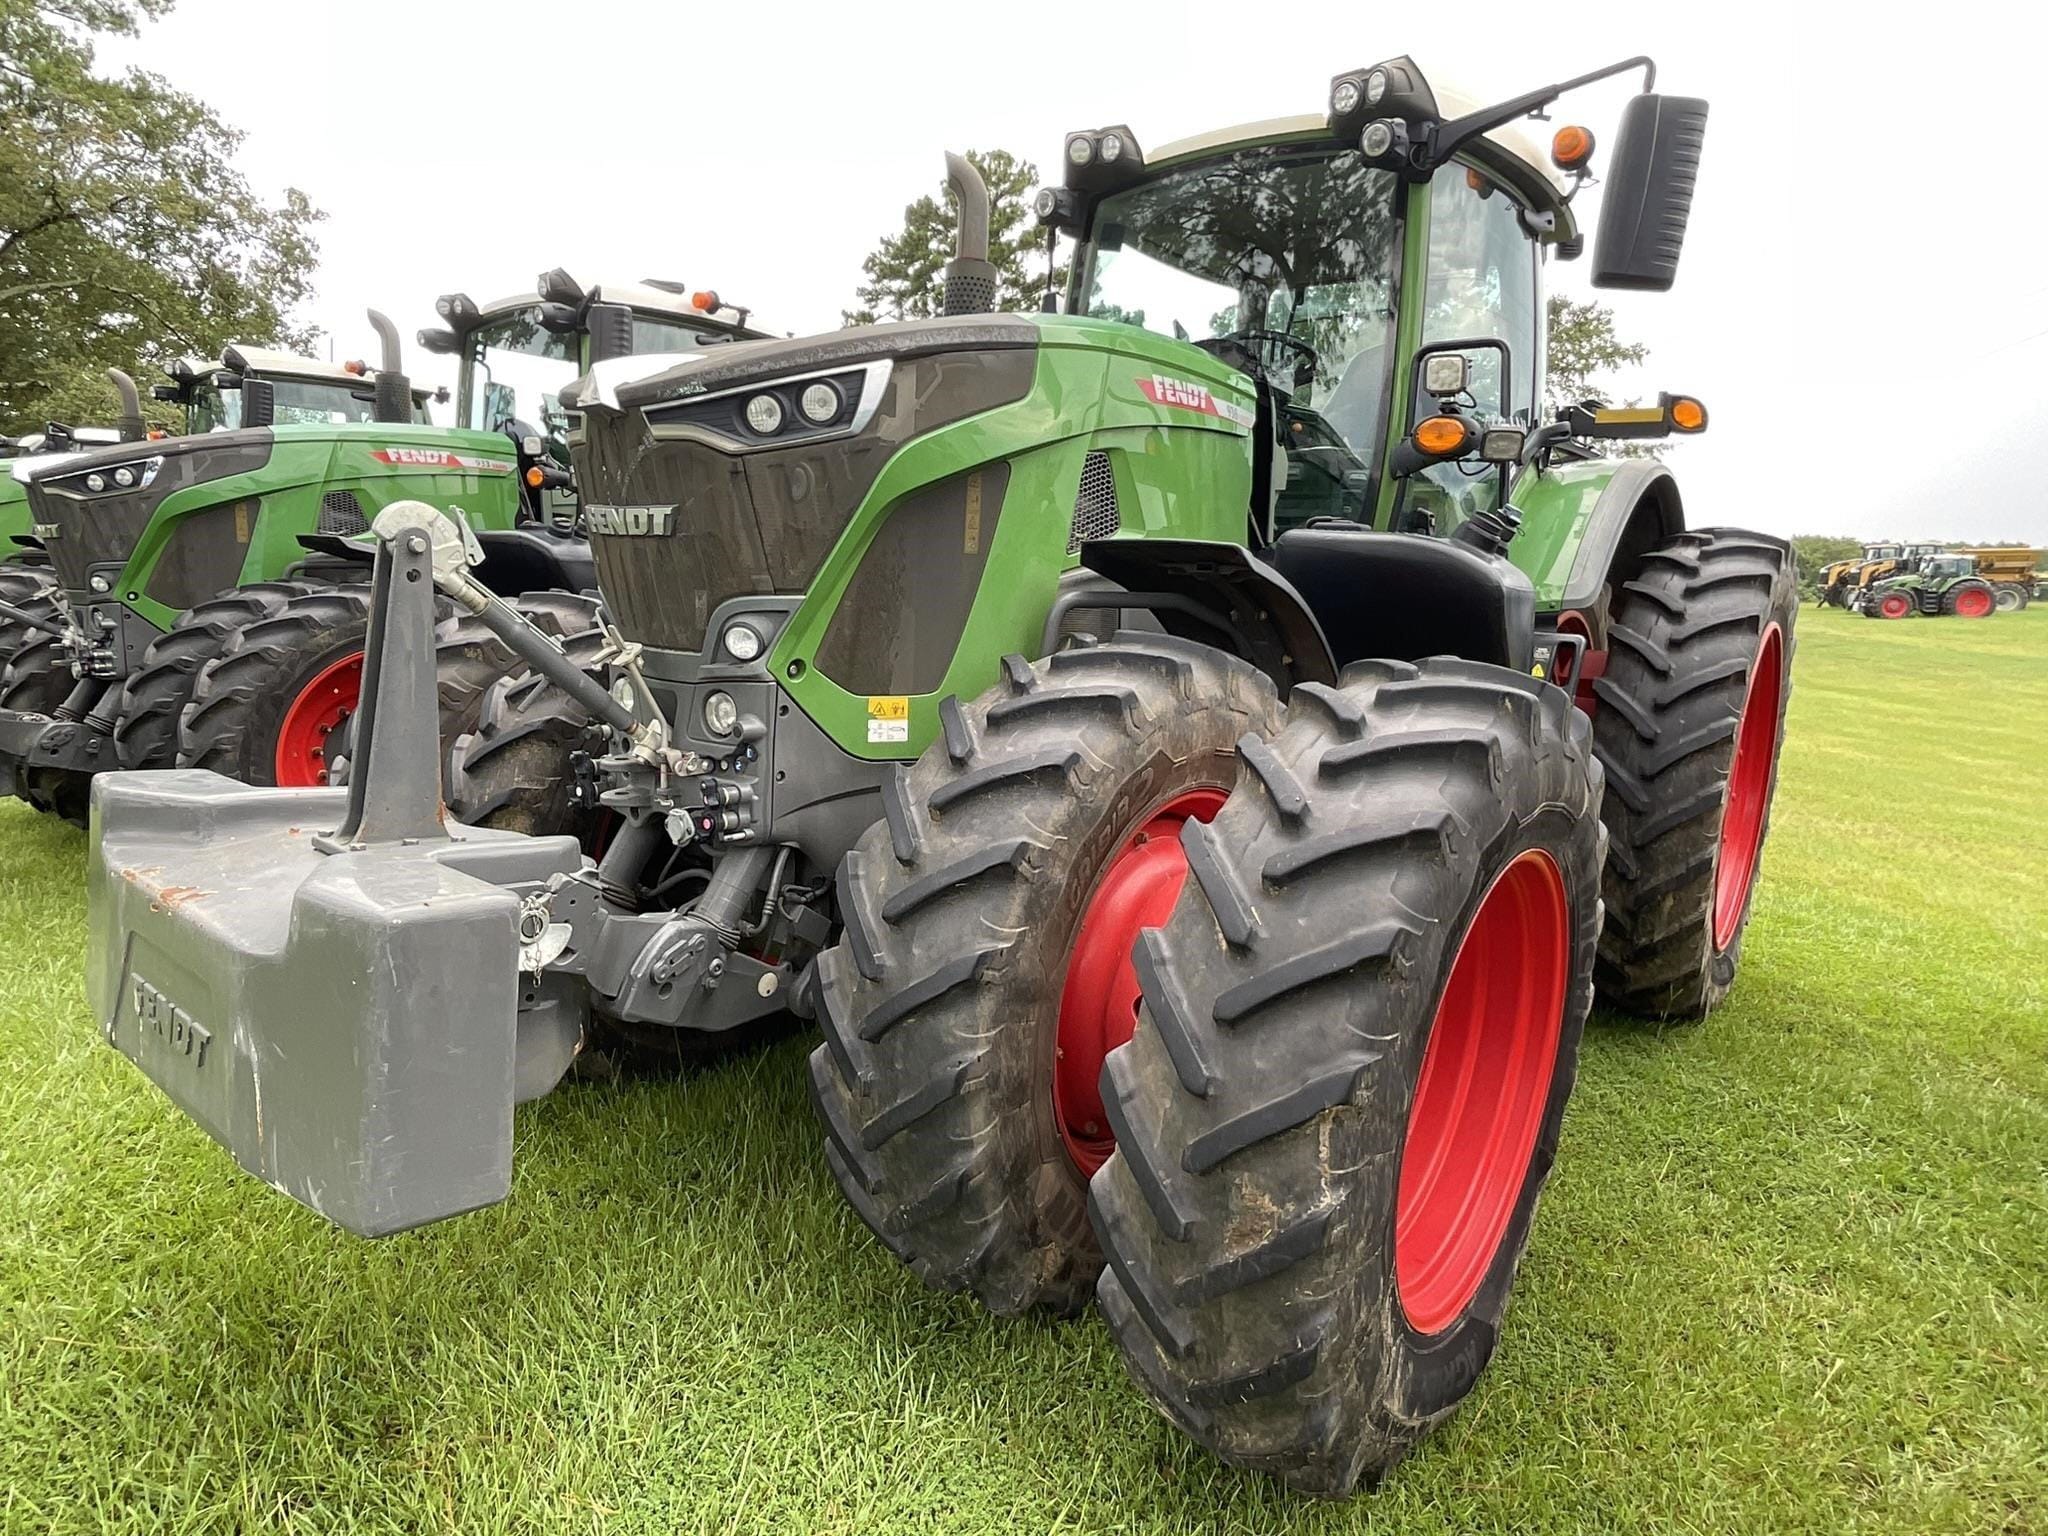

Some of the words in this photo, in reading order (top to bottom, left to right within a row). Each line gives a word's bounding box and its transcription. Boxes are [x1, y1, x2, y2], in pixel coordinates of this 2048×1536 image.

[1152, 374, 1208, 409] FENDT
[385, 448, 451, 464] FENDT
[585, 505, 675, 536] FENDT
[131, 973, 212, 1069] FENDT
